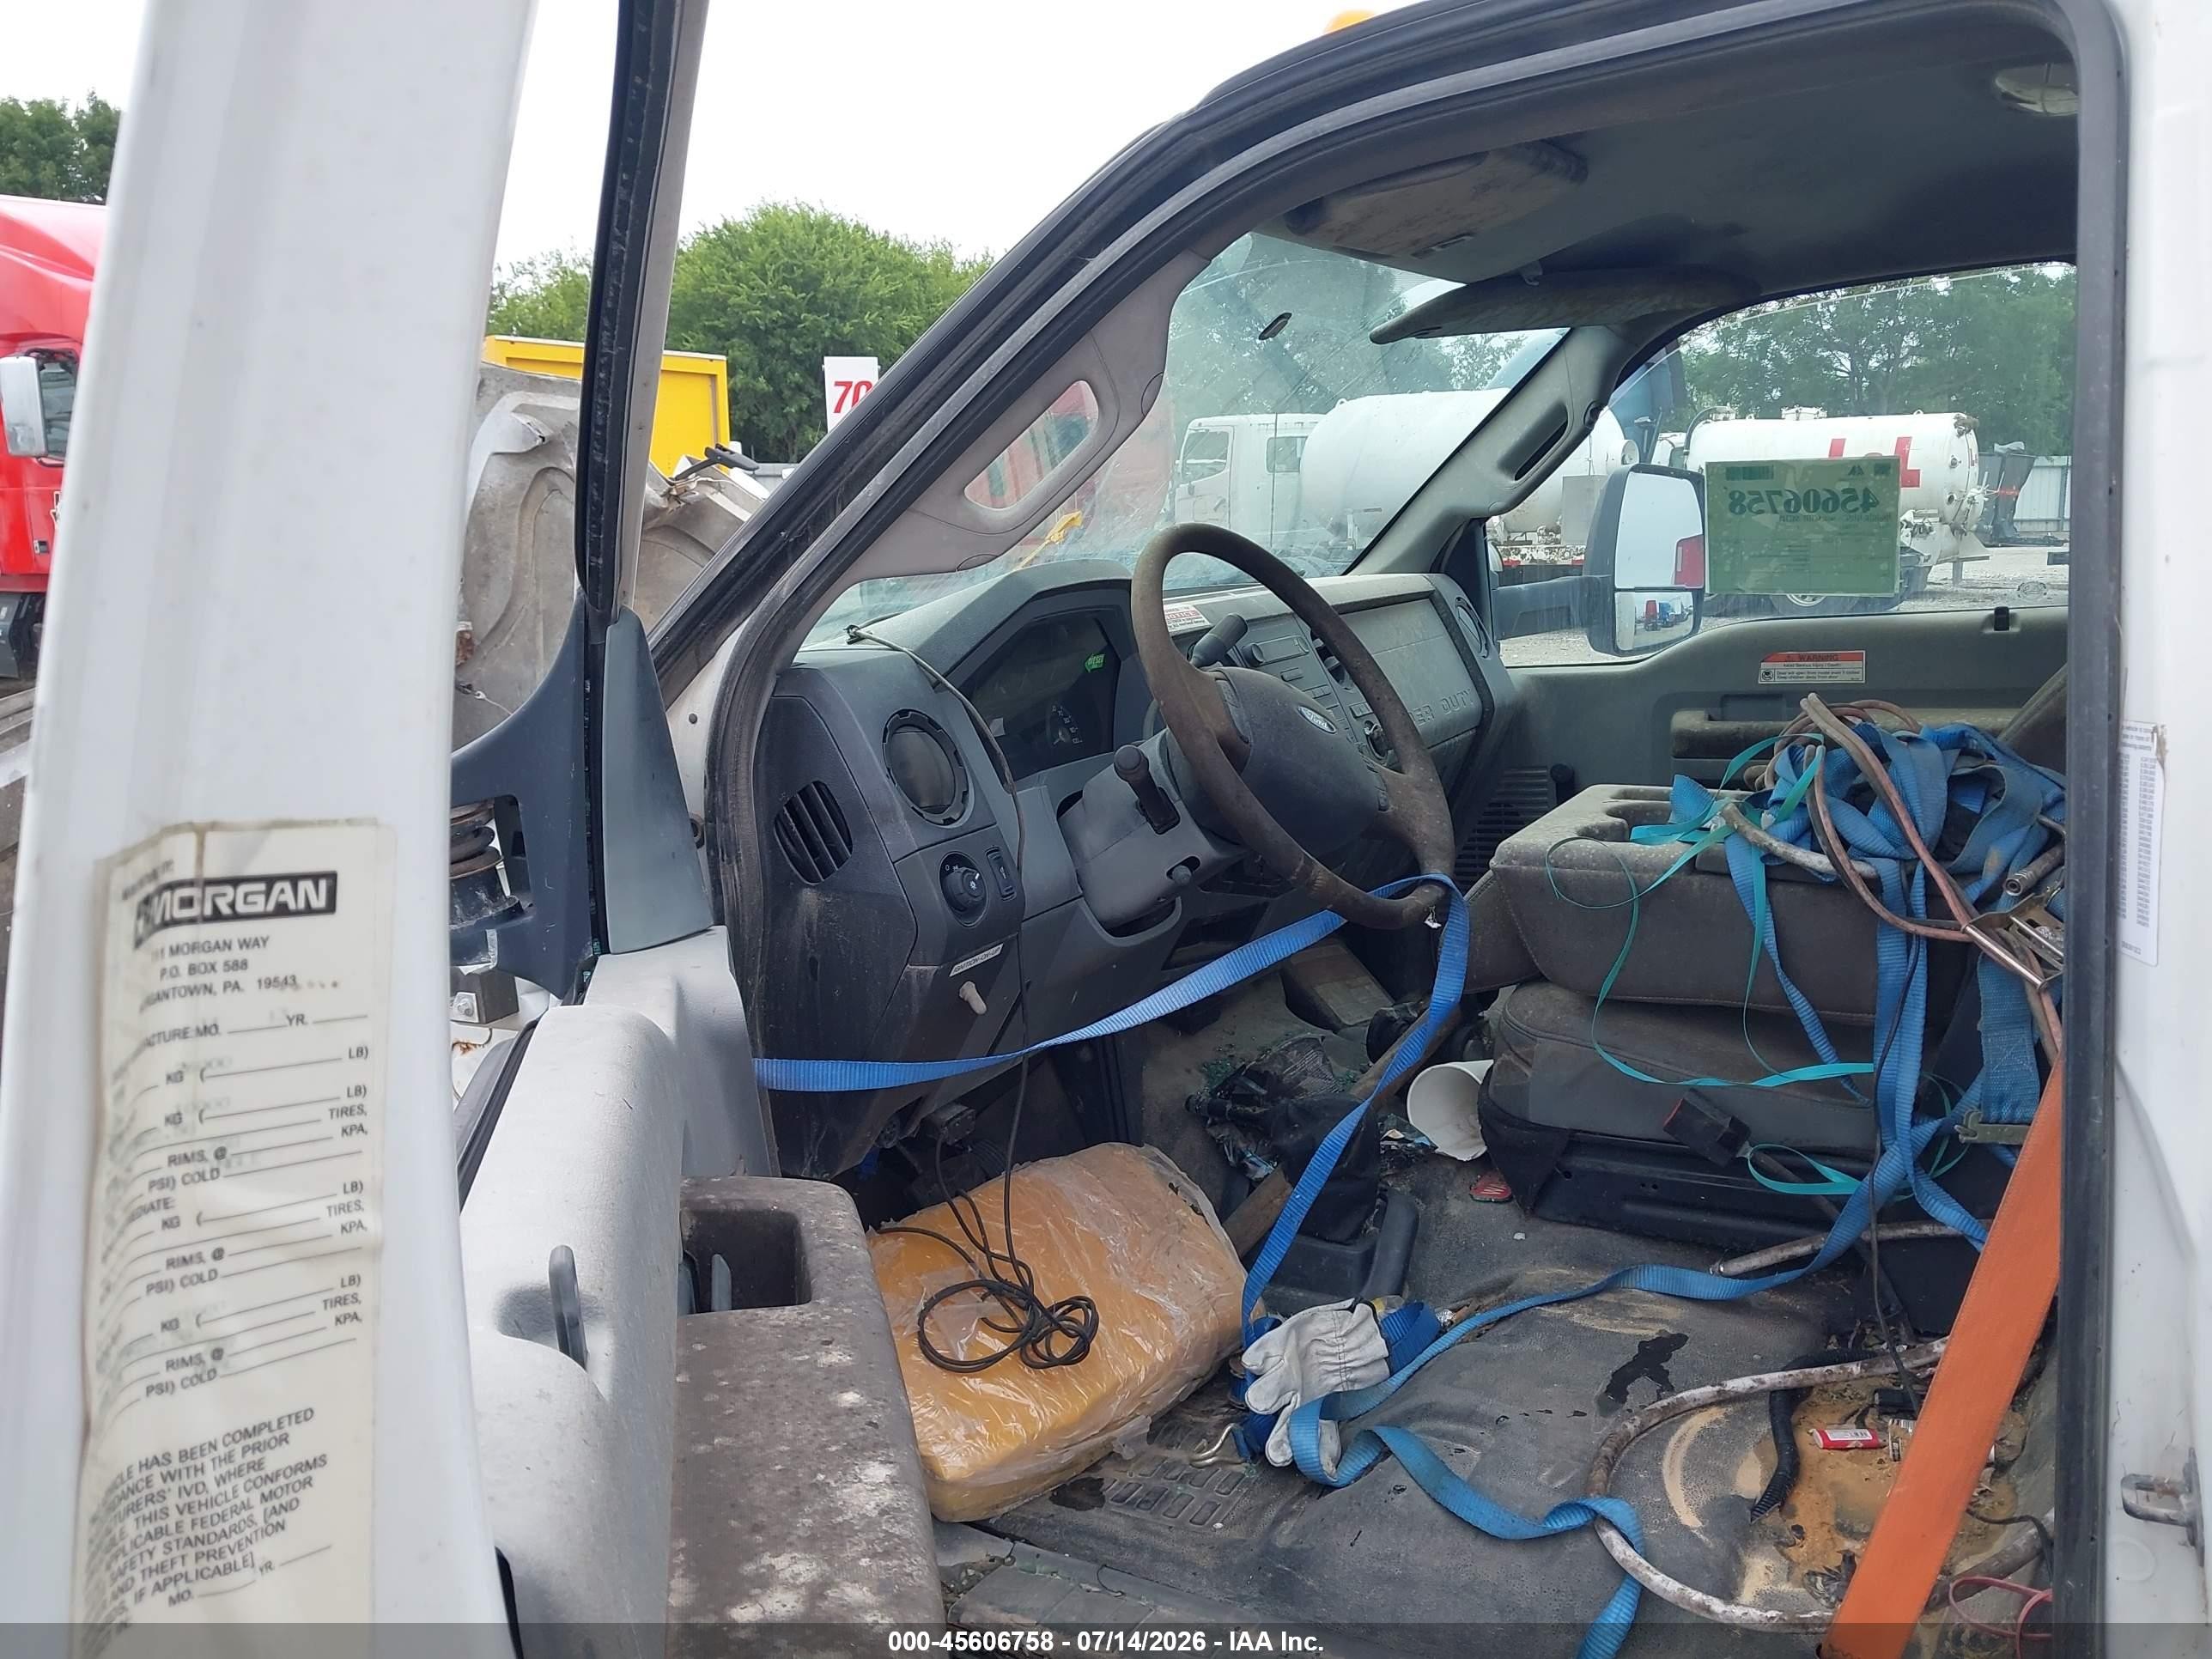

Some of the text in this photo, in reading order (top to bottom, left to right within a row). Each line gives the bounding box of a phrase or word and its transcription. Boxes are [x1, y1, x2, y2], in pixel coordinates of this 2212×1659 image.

[1440, 688, 1474, 714] DUTY
[152, 879, 327, 926] MORGAN
[169, 939, 232, 957] MORGAN
[237, 935, 270, 951] WAY
[187, 961, 217, 976] BOX
[222, 958, 248, 973] 588
[286, 1013, 308, 1026] YR.
[348, 1046, 369, 1060] LB)
[347, 1085, 368, 1099] LB)
[329, 1103, 368, 1120] TIRES,
[341, 1122, 368, 1138] KPA,
[148, 1167, 220, 1192] PSI) COLD
[343, 1180, 364, 1194] LB)
[325, 1199, 365, 1218] TIRES,
[340, 1219, 368, 1235] KPA,
[146, 1268, 218, 1296] PSI) COLD
[340, 1274, 362, 1289] LB)
[323, 1292, 362, 1310] TIRES,
[335, 1311, 362, 1327] KPA,
[146, 1368, 217, 1398] PSI) COLD
[138, 1451, 172, 1473] HAS
[179, 1438, 217, 1464] BEEN
[222, 1407, 314, 1448] COMPLETED
[160, 1462, 204, 1484] WITH
[211, 1449, 235, 1471] THE
[241, 1431, 289, 1458] PRIOR
[214, 1457, 265, 1489] WHERE
[135, 1453, 327, 1529] THIS VEHICLE CONFORMS
[191, 1498, 254, 1531] FEDERAL
[260, 1475, 313, 1504] MOTOR
[140, 1553, 188, 1582] THEFT
[195, 1519, 285, 1565] PREVENTION
[134, 1587, 146, 1605] IF
